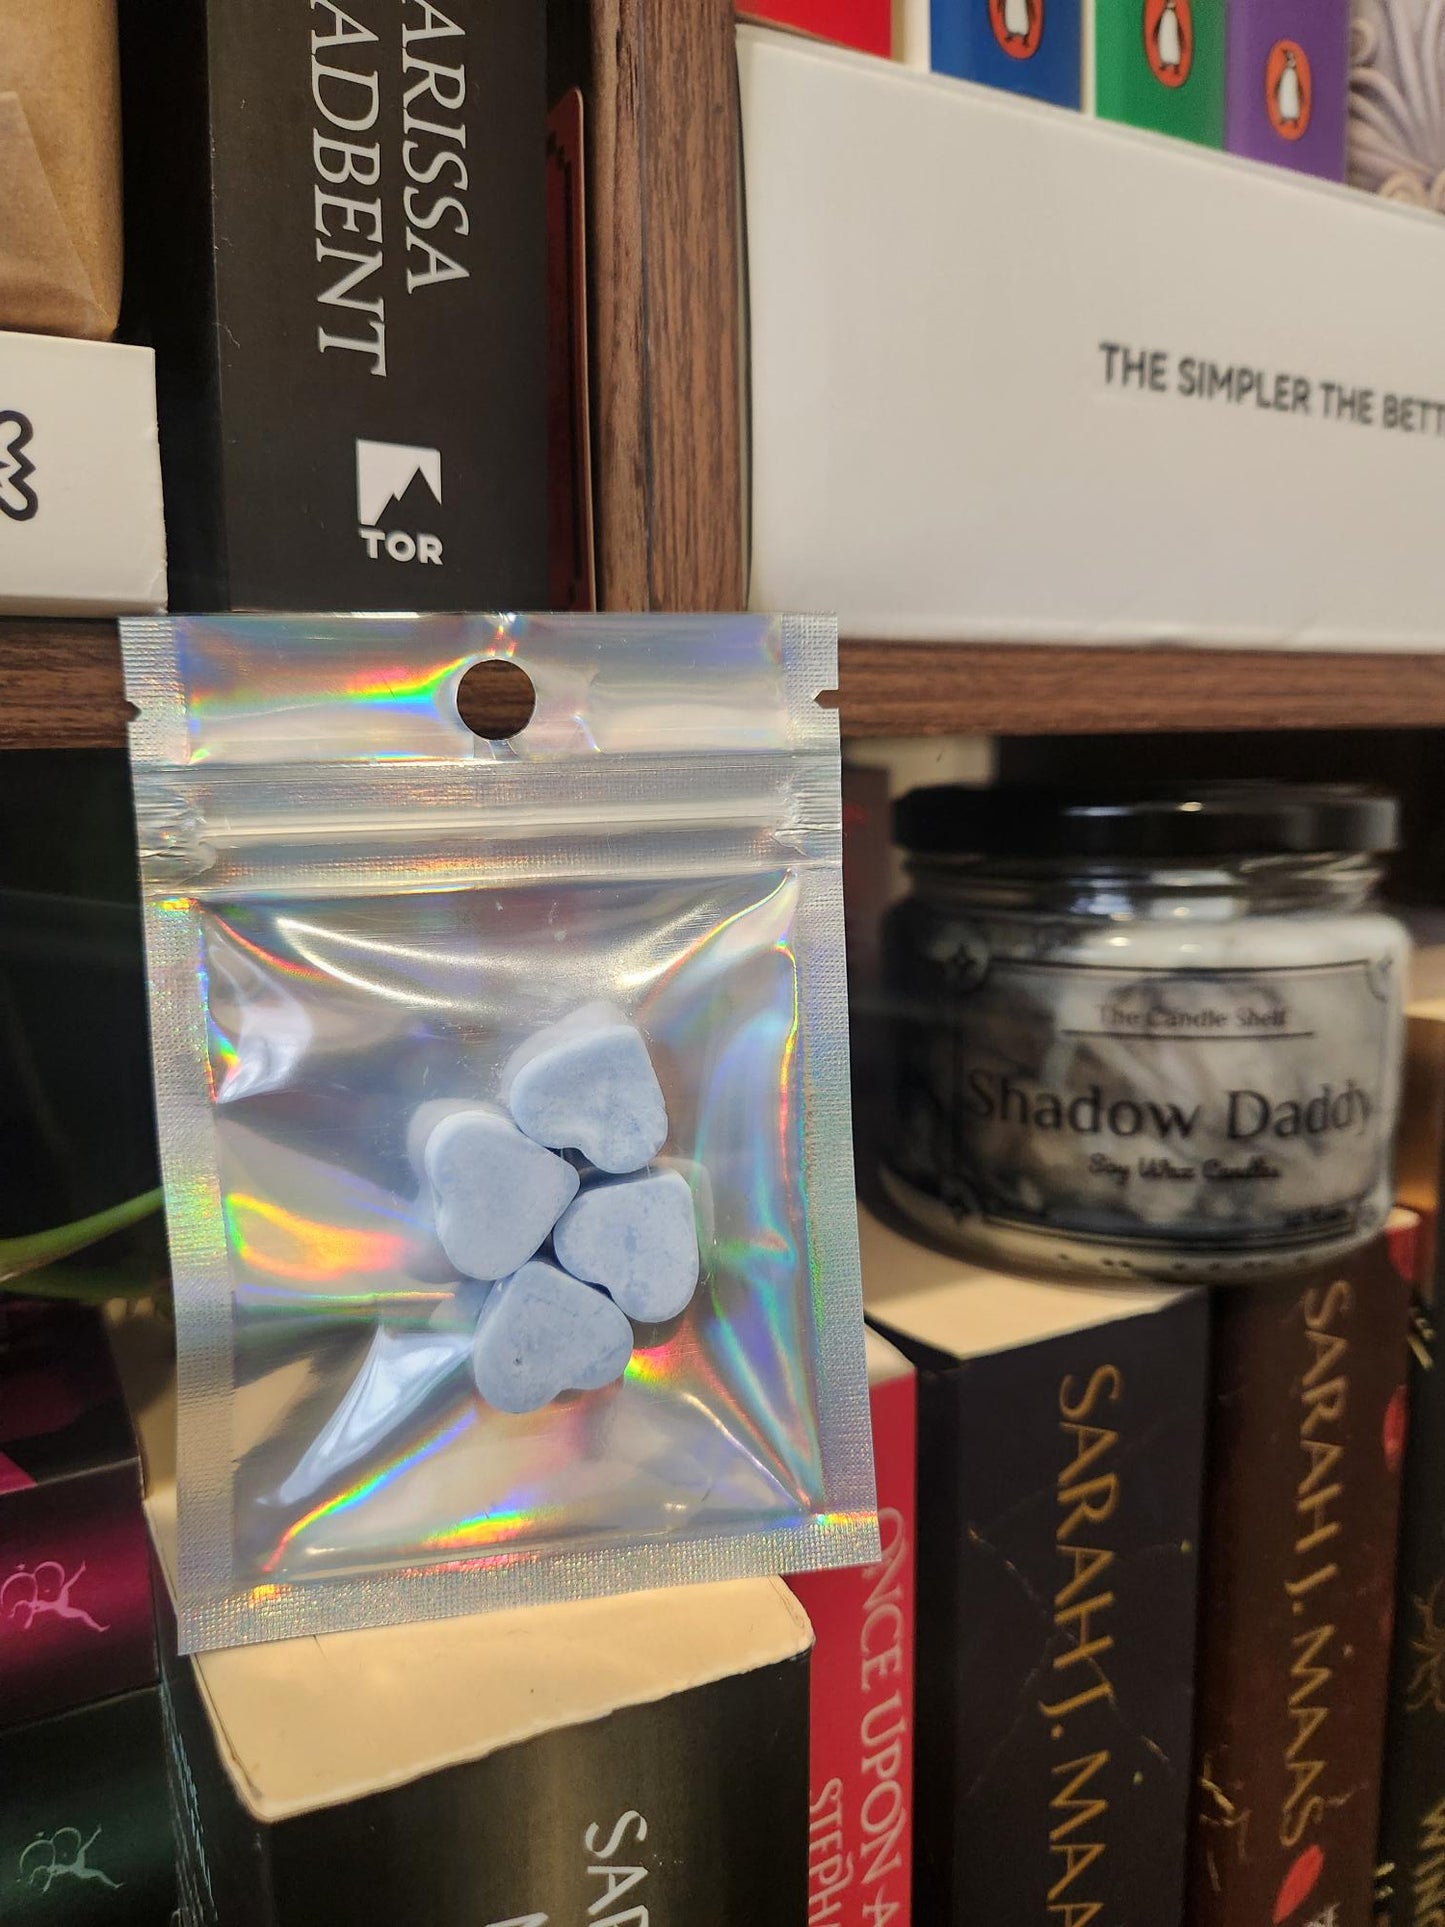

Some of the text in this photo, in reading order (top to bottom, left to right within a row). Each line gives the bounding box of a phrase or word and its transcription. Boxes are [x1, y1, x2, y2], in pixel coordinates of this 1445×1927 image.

[310, 0, 387, 378] ADBENT
[402, 0, 470, 295] ARISSA
[1099, 341, 1445, 436] THE SIMPLER THE BETT
[360, 528, 443, 566] TOR
[967, 1068, 1371, 1142] Shadow Daddy
[1294, 1280, 1352, 1554] SARAH
[860, 1506, 906, 1690] ONCE
[1053, 1363, 1123, 1670] SARAH
[1284, 1562, 1338, 1614] J.
[859, 1689, 906, 1885] UPON
[1038, 1682, 1114, 1739] J.
[1279, 1624, 1335, 1847] MAAS
[809, 1777, 854, 1927] STEPH
